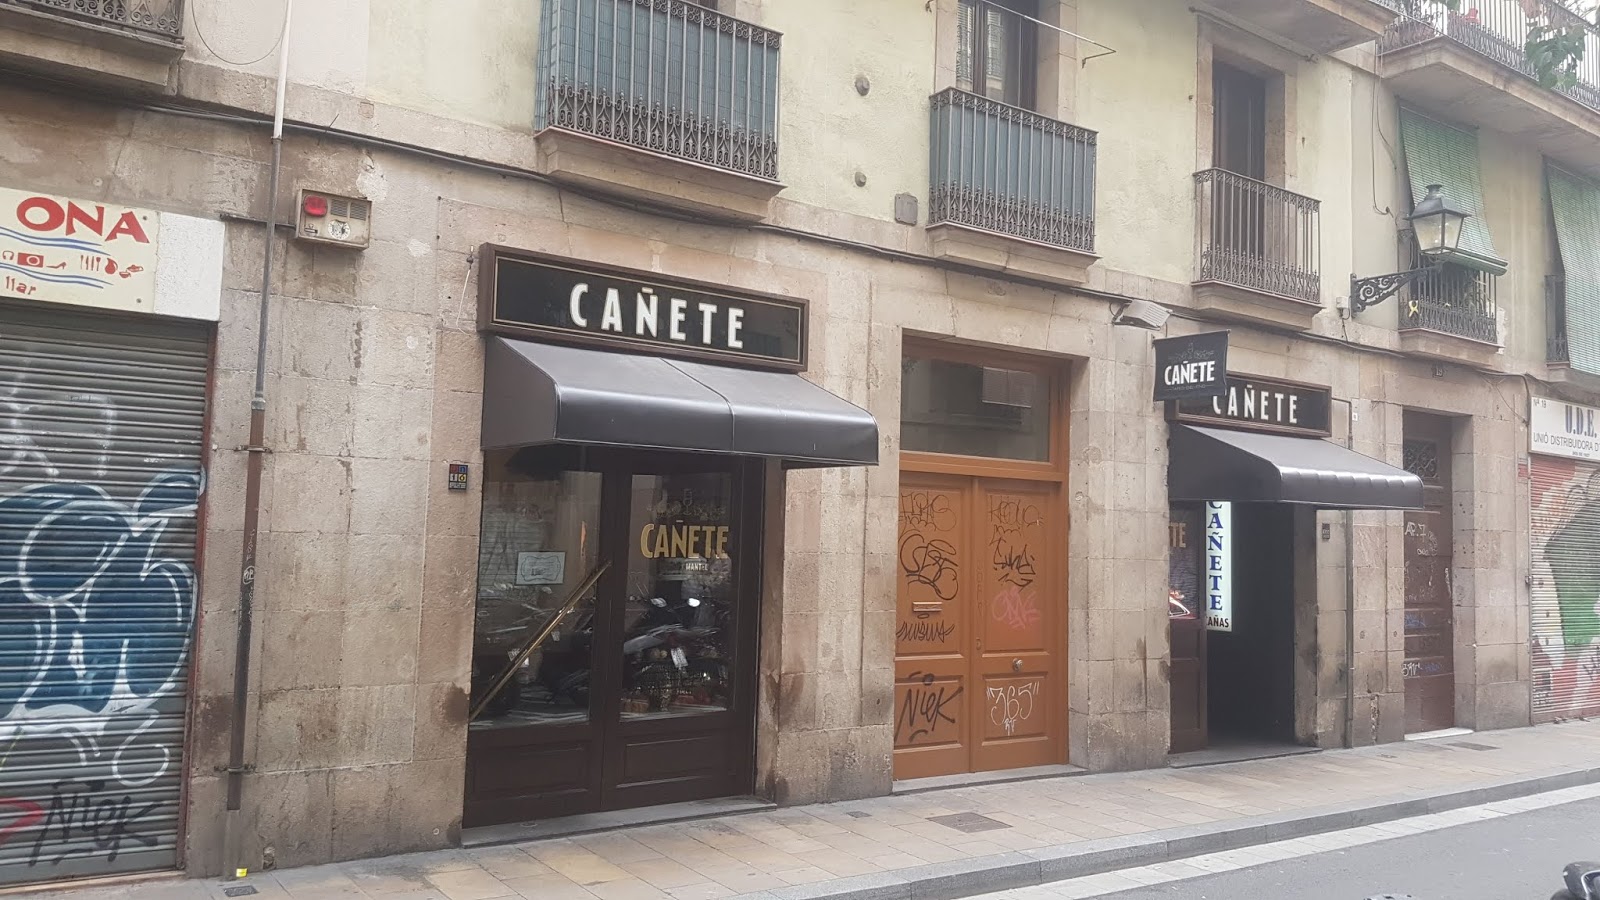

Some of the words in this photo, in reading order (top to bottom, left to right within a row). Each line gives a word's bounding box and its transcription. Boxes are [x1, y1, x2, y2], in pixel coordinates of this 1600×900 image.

[16, 196, 150, 243] ONA
[6, 276, 36, 295] llar
[569, 282, 745, 349] CAÑETE
[1164, 360, 1216, 385] CAÑETE
[640, 519, 729, 559] CAÑETE
